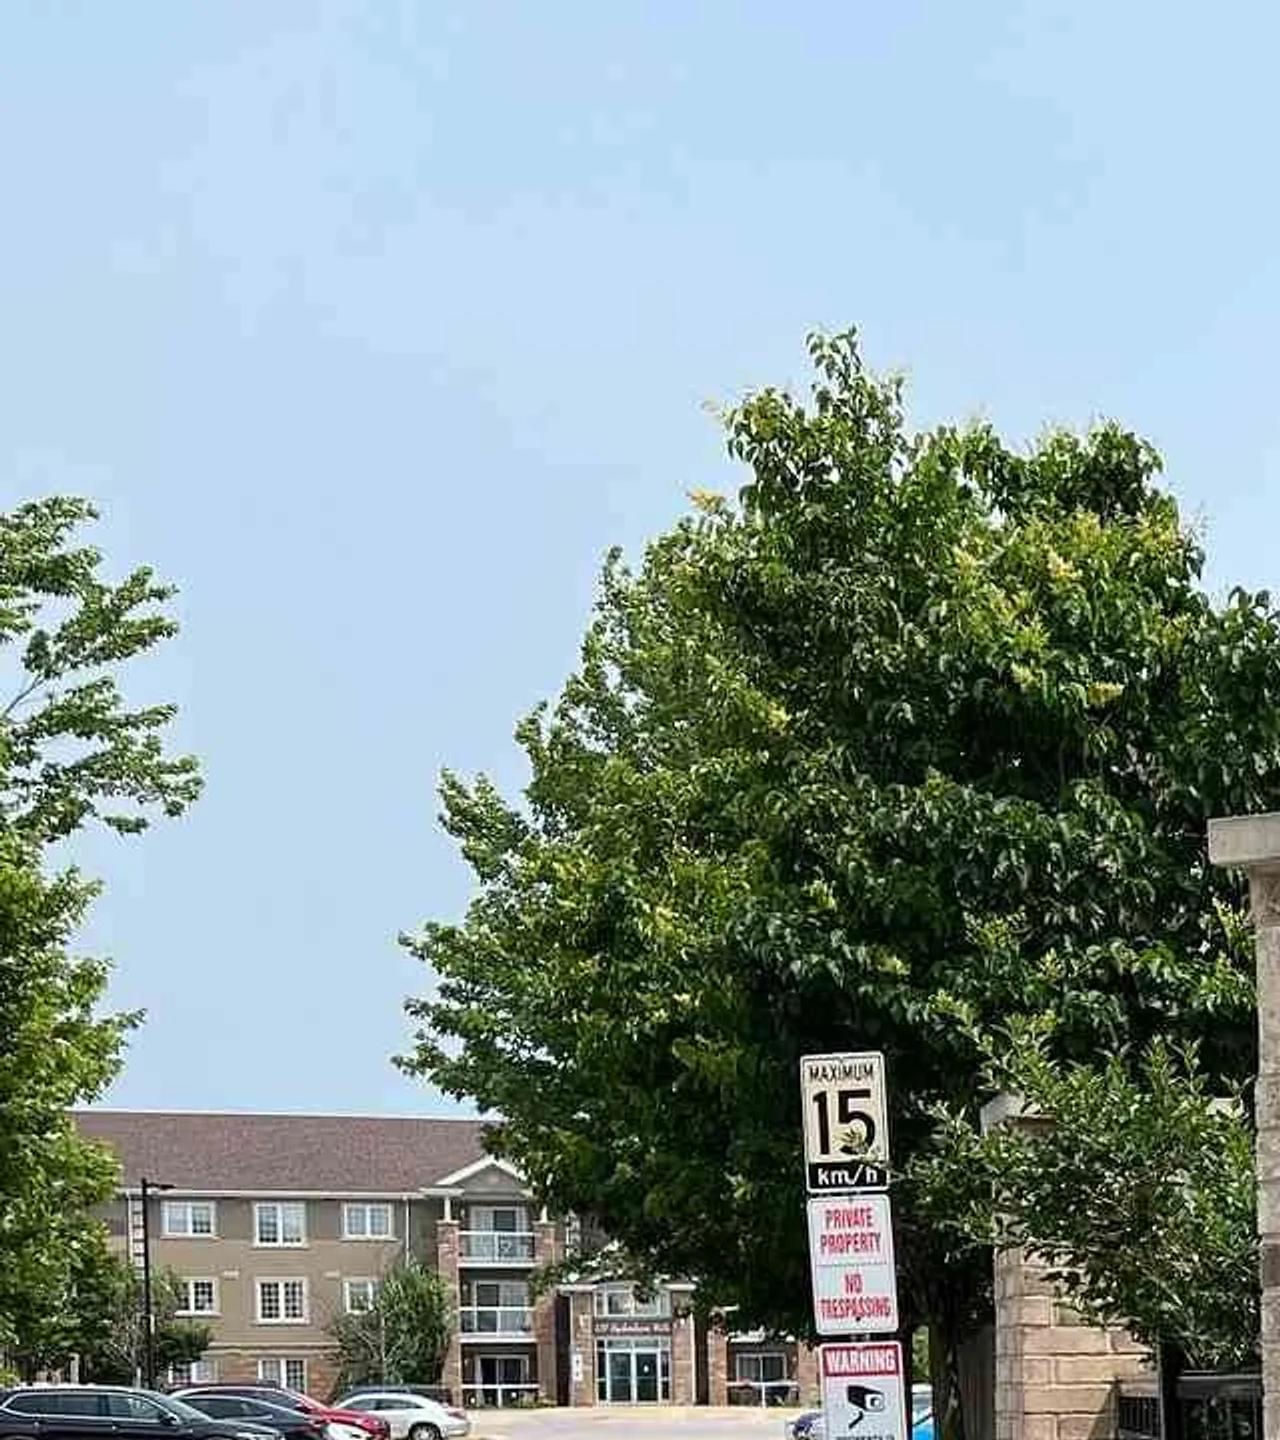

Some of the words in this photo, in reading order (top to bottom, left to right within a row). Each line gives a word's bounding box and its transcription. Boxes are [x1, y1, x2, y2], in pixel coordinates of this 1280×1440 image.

[809, 1063, 874, 1081] MAXIMUM
[812, 1089, 875, 1155] 15
[818, 1164, 878, 1185] km/h
[825, 1207, 872, 1229] PRIVATE
[820, 1232, 881, 1254] PROPERTY
[844, 1273, 862, 1294] NO
[820, 1297, 891, 1319] TRESPASSING
[824, 1349, 895, 1373] WARNING
